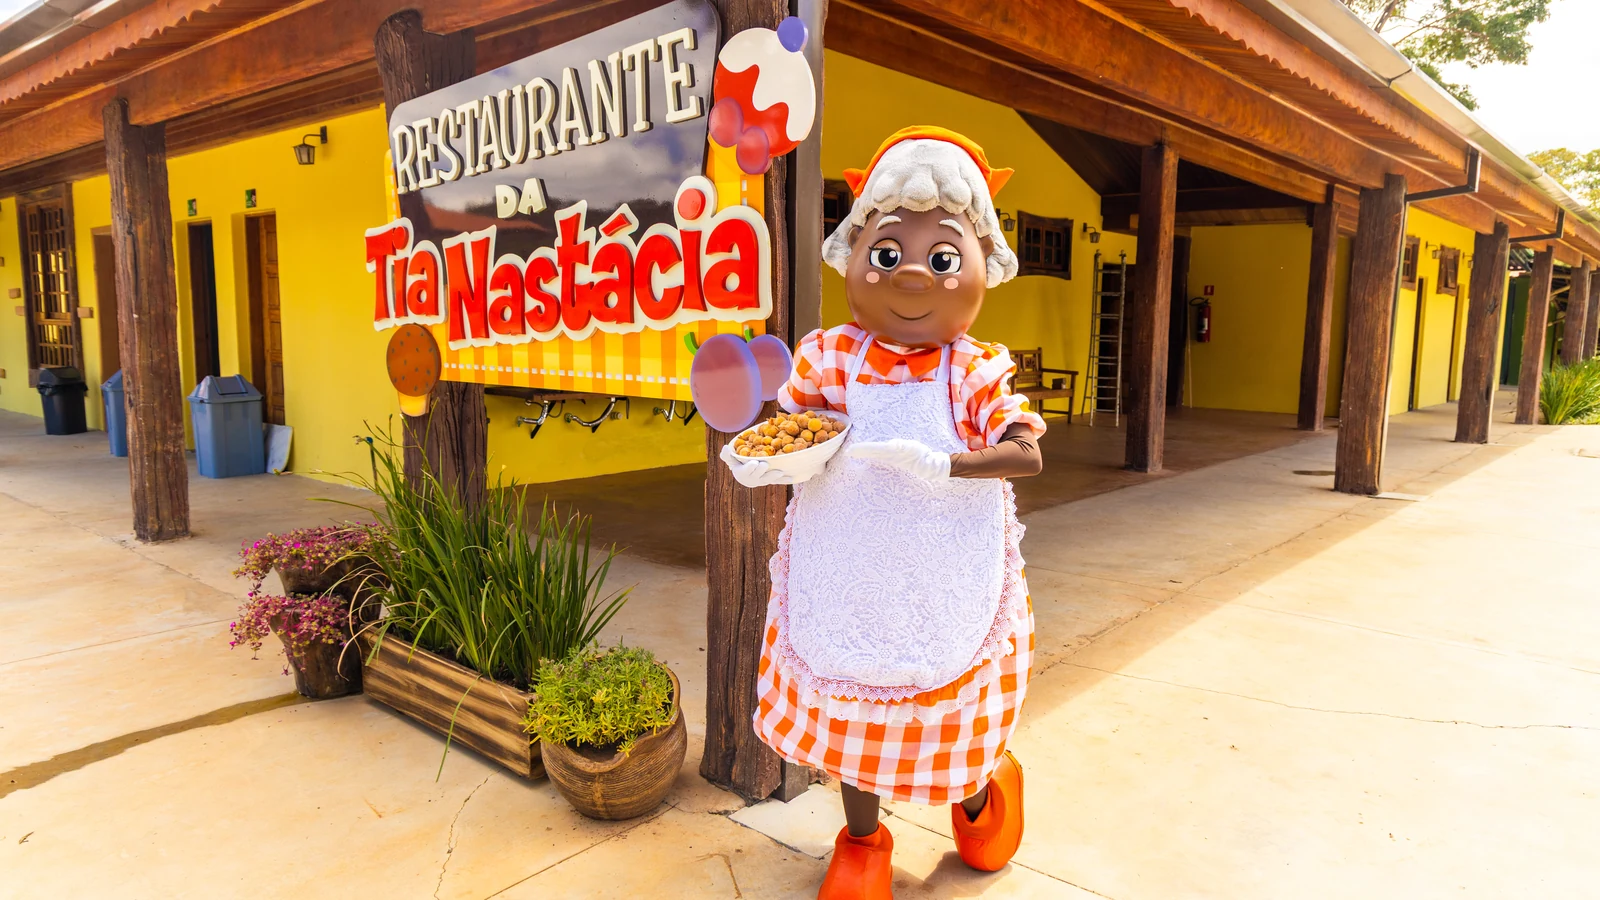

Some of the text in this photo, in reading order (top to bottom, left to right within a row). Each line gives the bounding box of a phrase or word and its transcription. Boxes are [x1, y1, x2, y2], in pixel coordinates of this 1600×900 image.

[393, 27, 703, 193] RESTAURANTE
[366, 189, 762, 342] Tia Nastácia
[495, 177, 547, 218] DA
